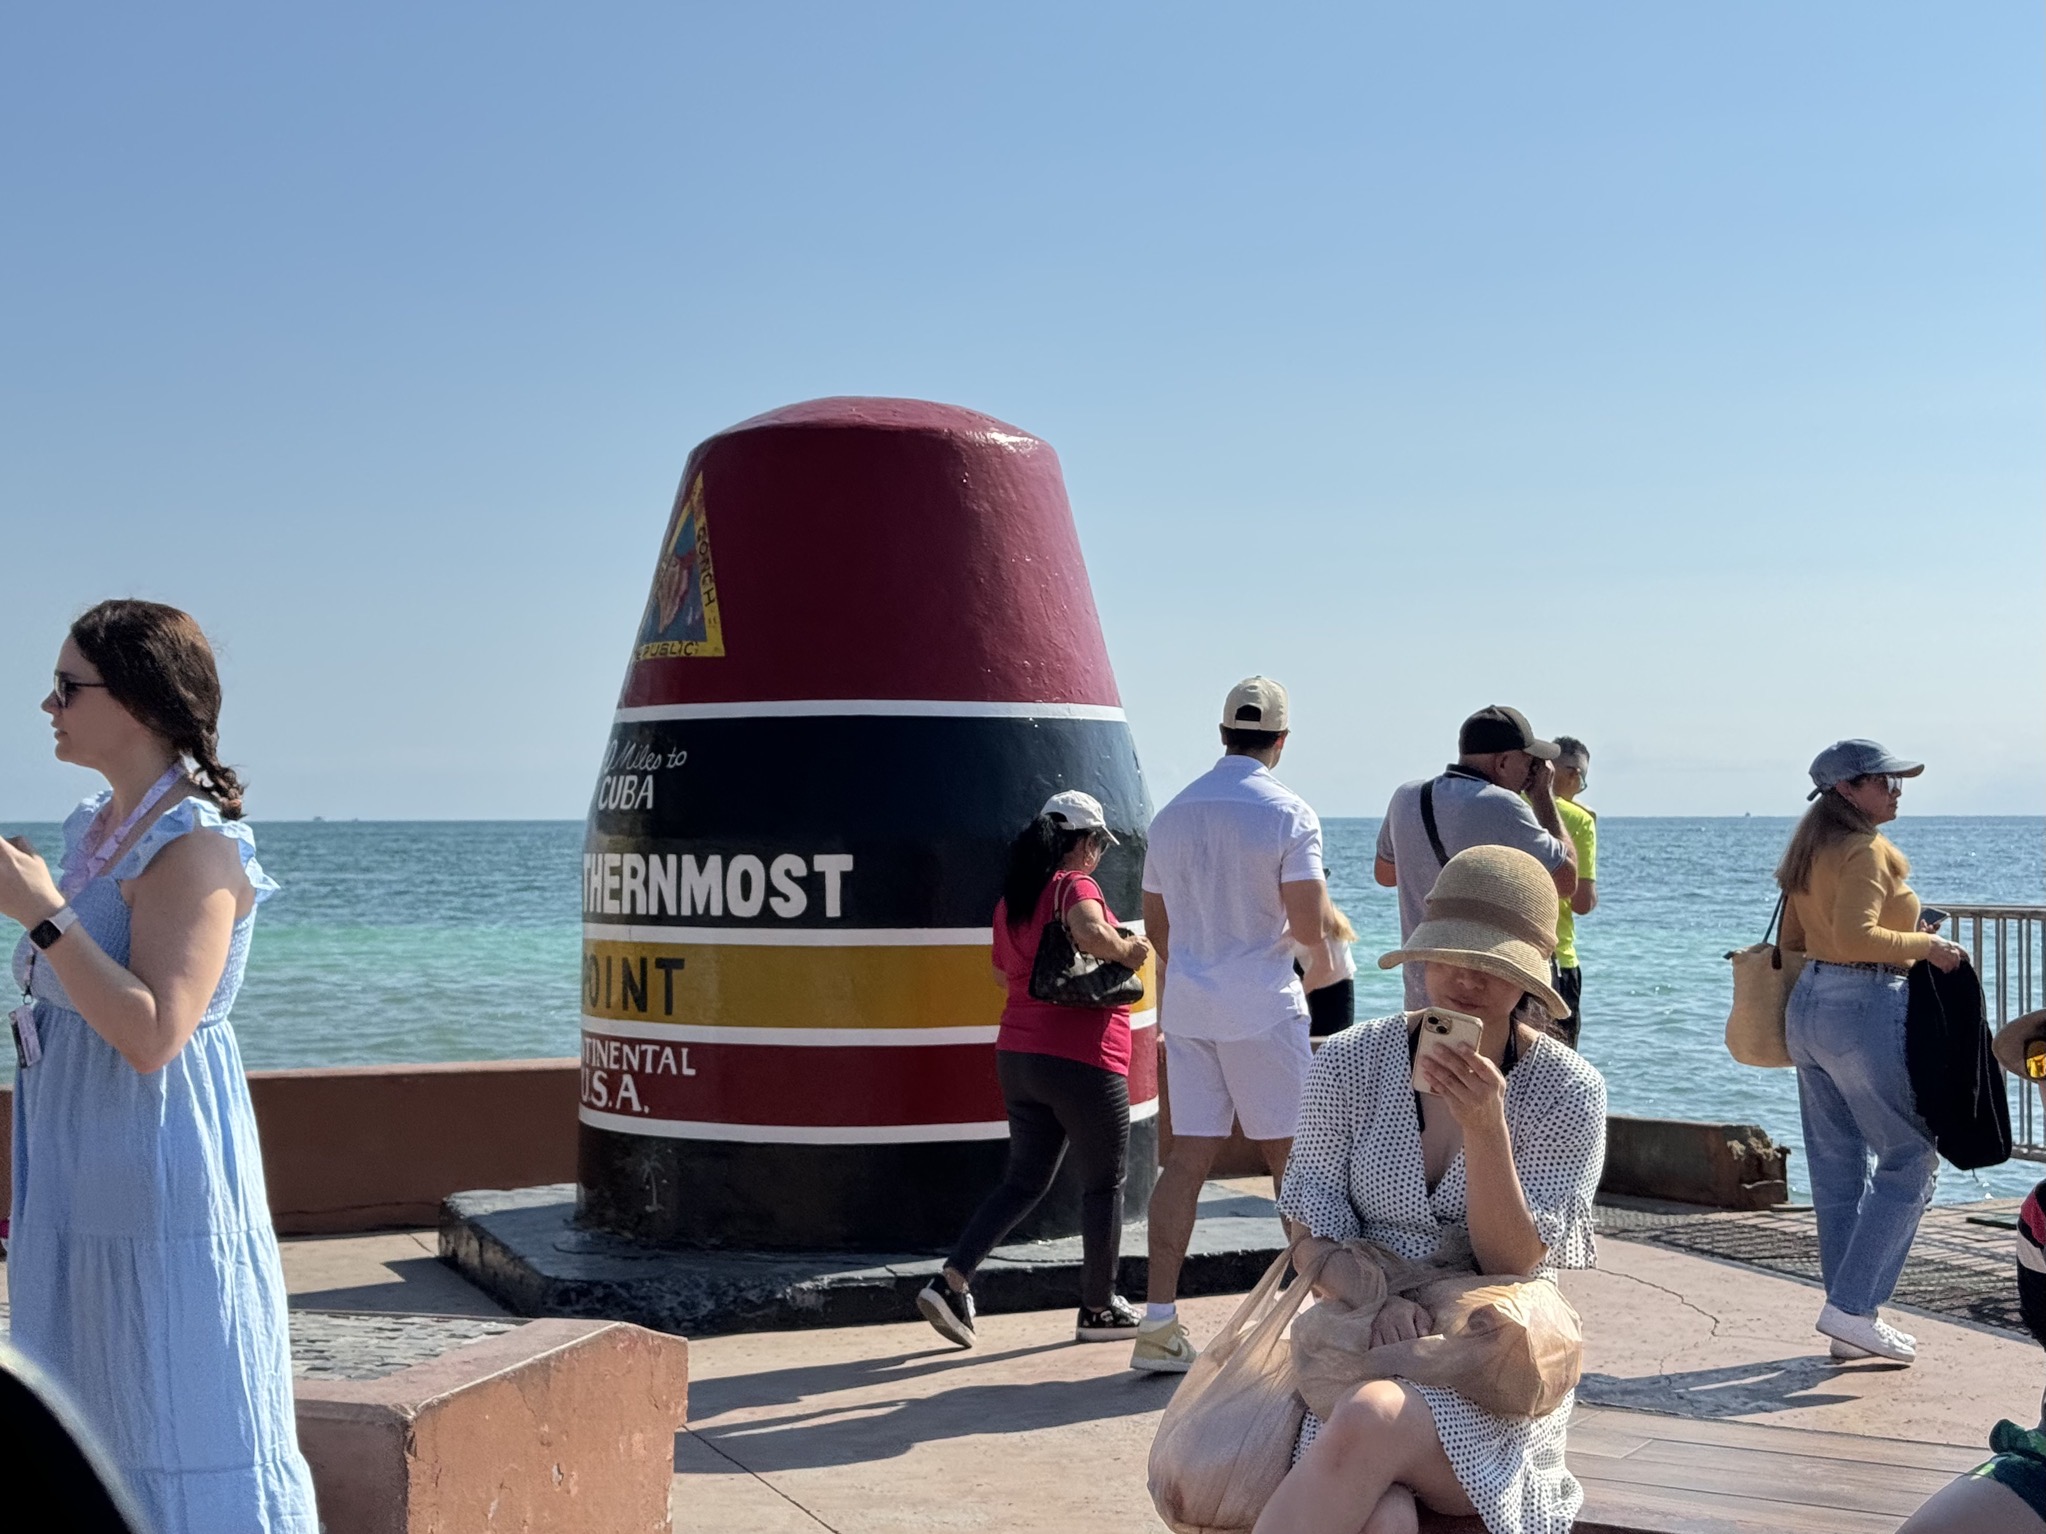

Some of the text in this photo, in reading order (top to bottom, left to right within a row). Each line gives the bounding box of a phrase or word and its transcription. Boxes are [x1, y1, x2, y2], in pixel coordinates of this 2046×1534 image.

[697, 526, 716, 607] CONCH
[611, 740, 662, 771] Miles
[666, 745, 688, 769] to
[598, 774, 654, 810] CUBA
[584, 853, 854, 918] THERNMOST
[581, 1067, 650, 1114] U.S.A.
